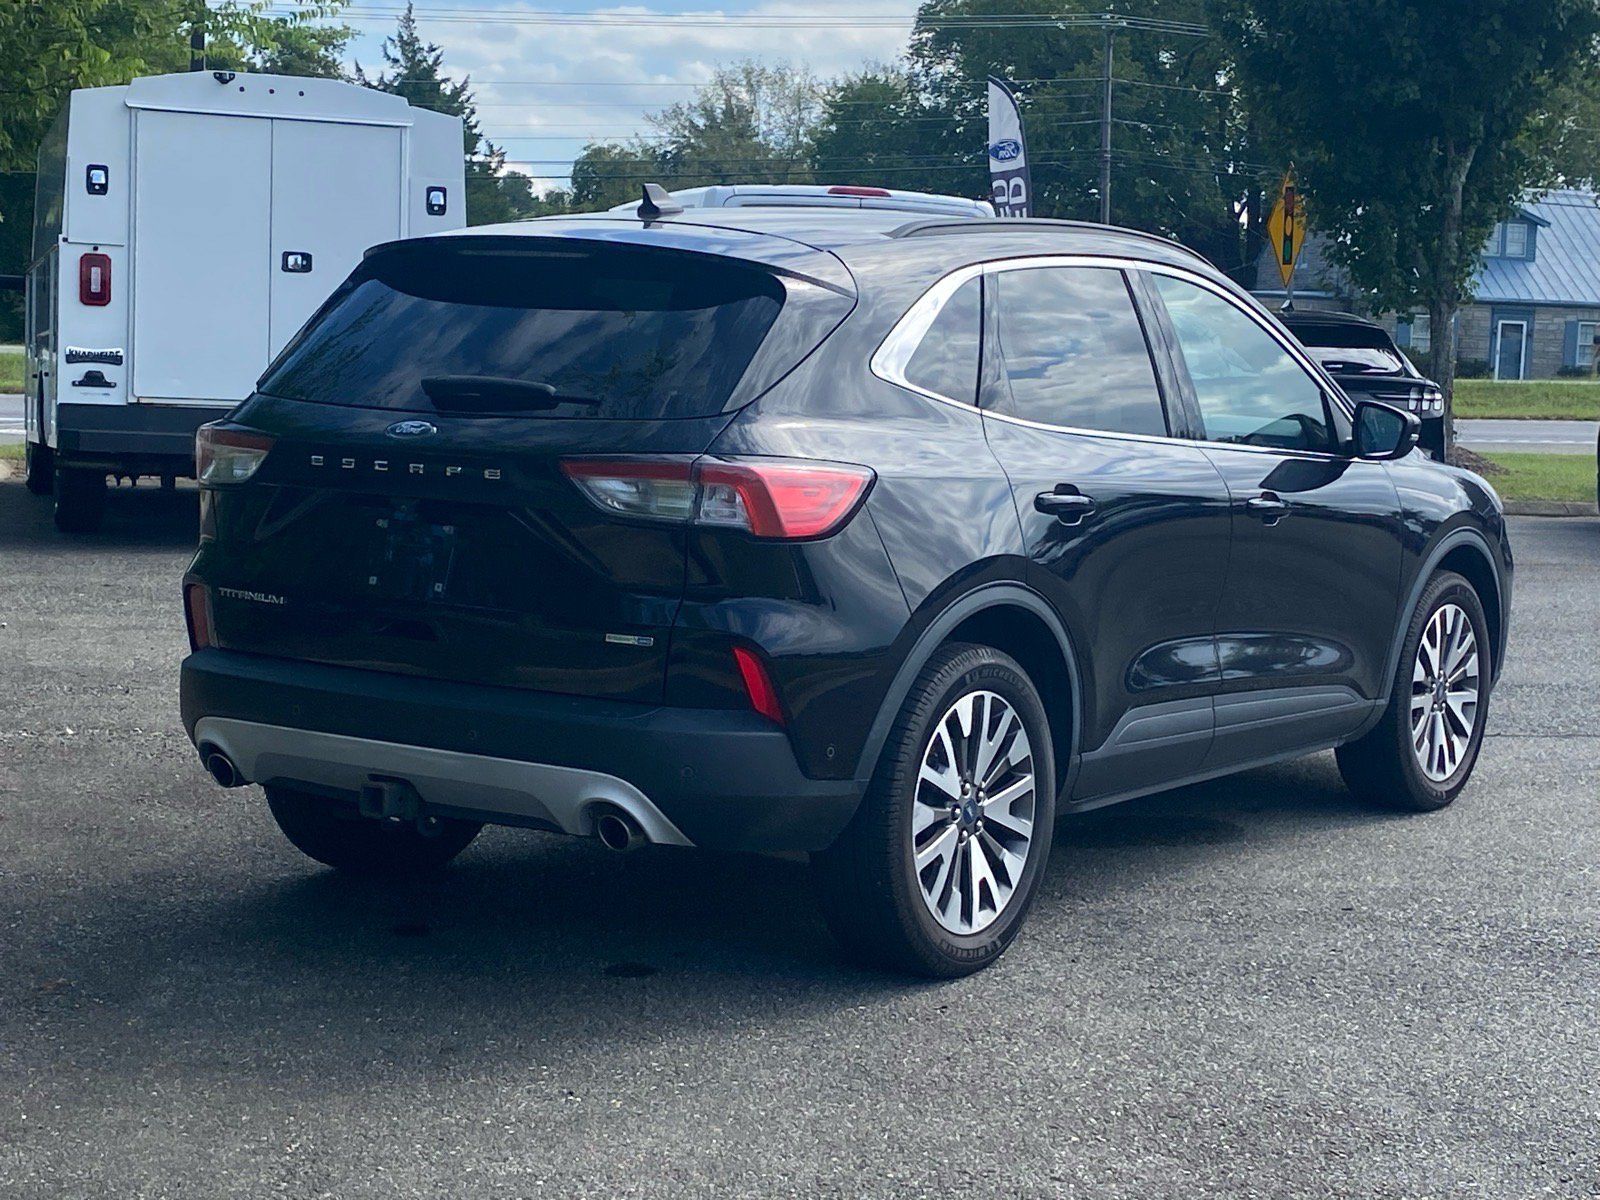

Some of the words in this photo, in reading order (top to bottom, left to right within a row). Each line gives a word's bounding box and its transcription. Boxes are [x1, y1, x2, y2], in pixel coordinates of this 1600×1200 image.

[392, 421, 429, 436] Ford
[311, 455, 501, 480] ESCAPE
[218, 586, 285, 605] TITANIUM
